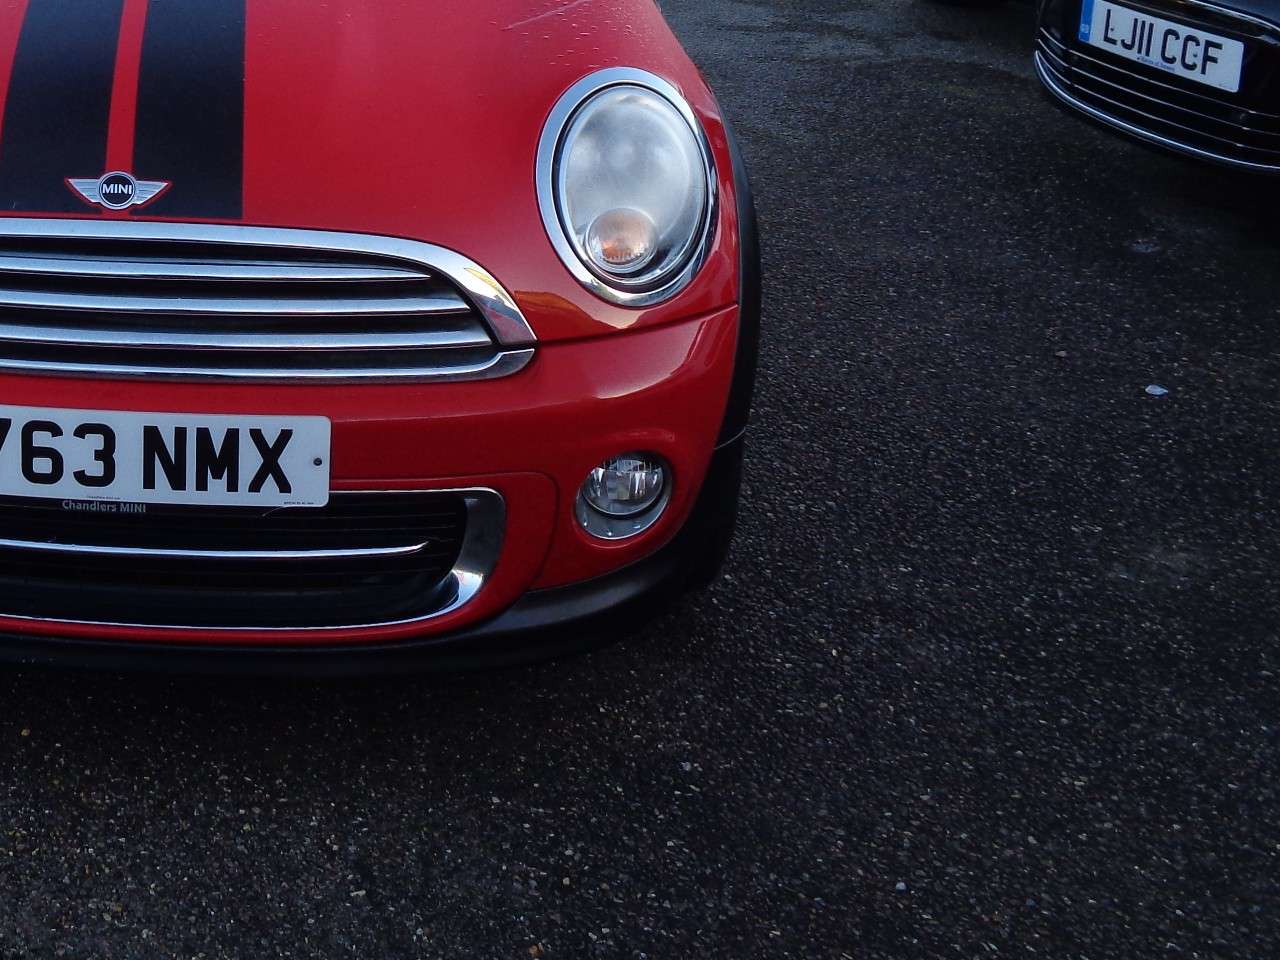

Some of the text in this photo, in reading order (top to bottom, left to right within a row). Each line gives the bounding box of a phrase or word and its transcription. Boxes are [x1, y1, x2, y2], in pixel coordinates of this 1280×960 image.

[1103, 8, 1224, 76] LJ11 CCF
[102, 183, 133, 195] MINI
[142, 425, 294, 495] NMX
[62, 500, 146, 513] Chandlers MINI
